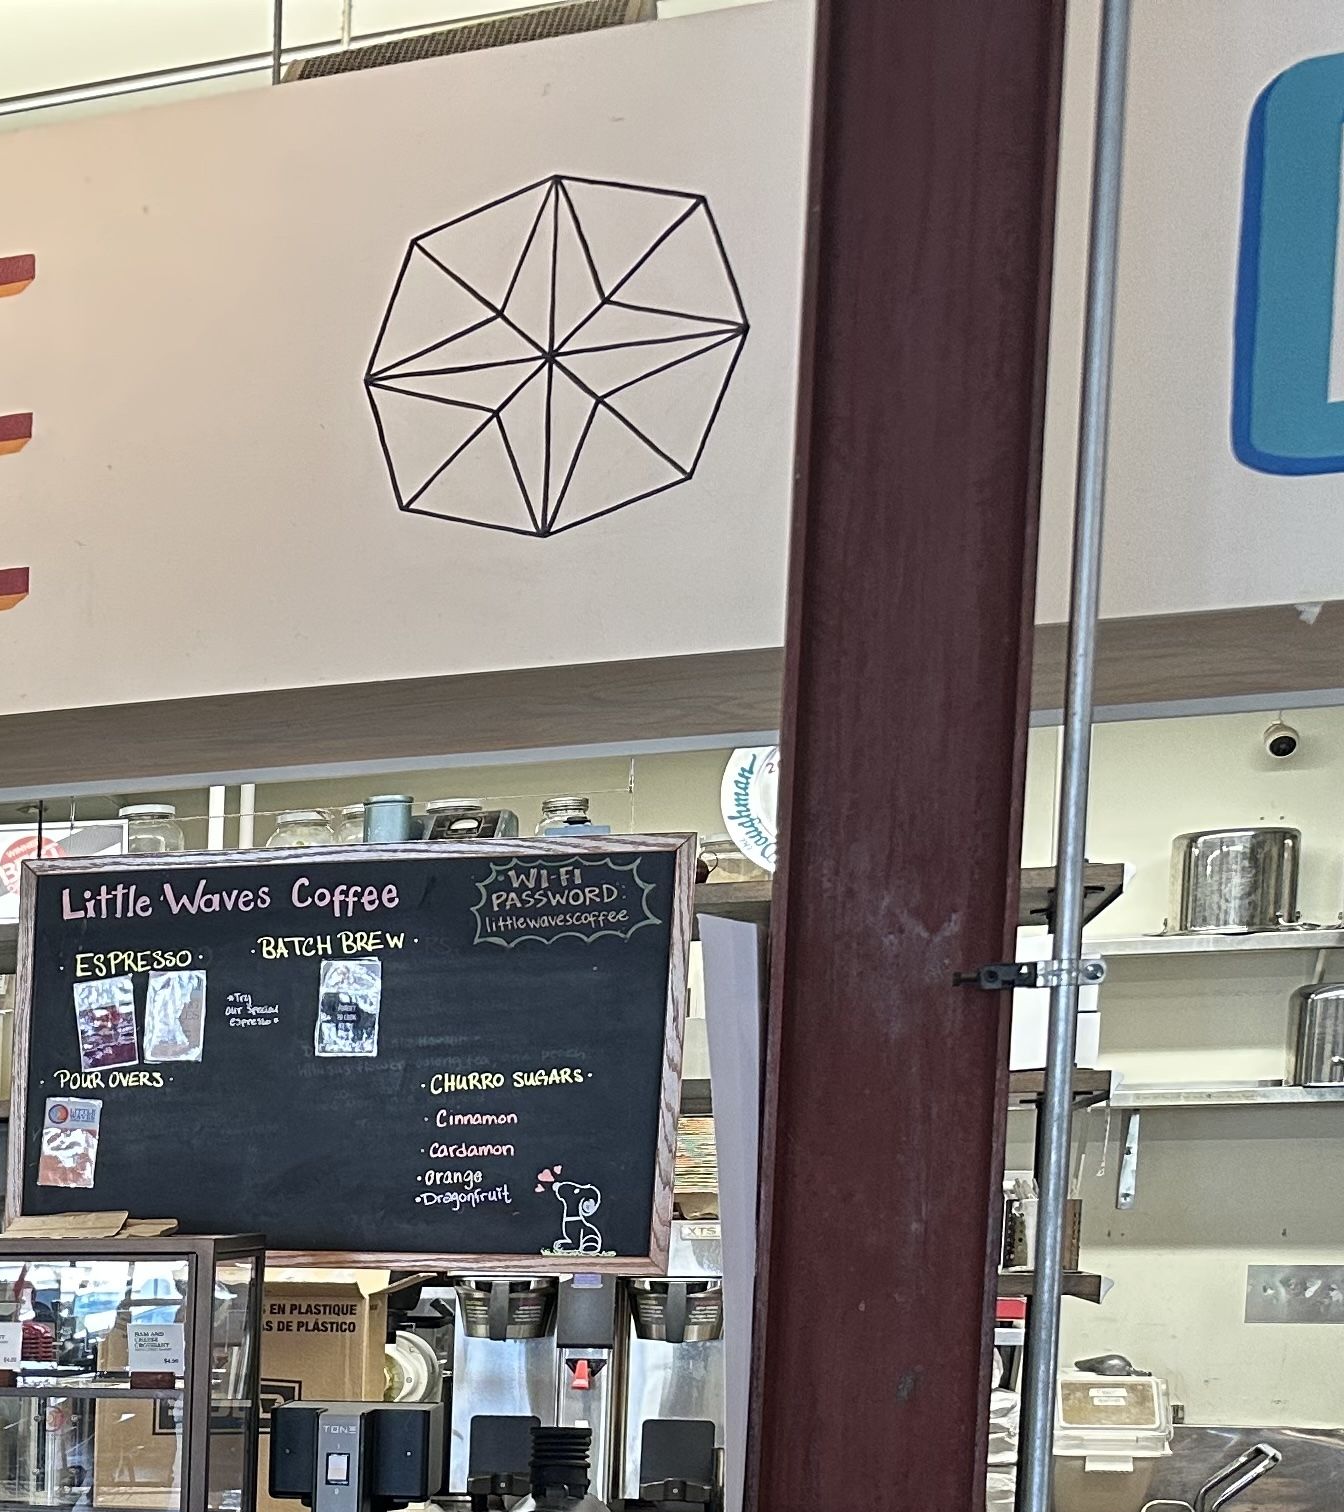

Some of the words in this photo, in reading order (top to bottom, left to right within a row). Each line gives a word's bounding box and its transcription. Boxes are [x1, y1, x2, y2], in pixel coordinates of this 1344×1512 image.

[508, 866, 582, 889] WI-FI
[61, 884, 153, 921] Little
[163, 879, 271, 915] Waves
[292, 877, 400, 917] Coffee
[485, 909, 630, 933] littlewavescoffee
[257, 935, 332, 960] BATCH
[337, 931, 405, 956] BREW
[75, 950, 192, 977] ESPRESSO
[54, 1072, 103, 1090] POUR
[109, 1070, 164, 1088] OVERS
[430, 1072, 505, 1095] CHURRO
[513, 1067, 584, 1088] SUGARS
[436, 1109, 518, 1128] Cinnamon
[429, 1142, 515, 1158] Cardamon
[269, 1303, 286, 1315] EN
[289, 1303, 357, 1316] PLASTIQUE
[277, 1320, 293, 1332] DE
[296, 1318, 356, 1333] PLÁSTICO
